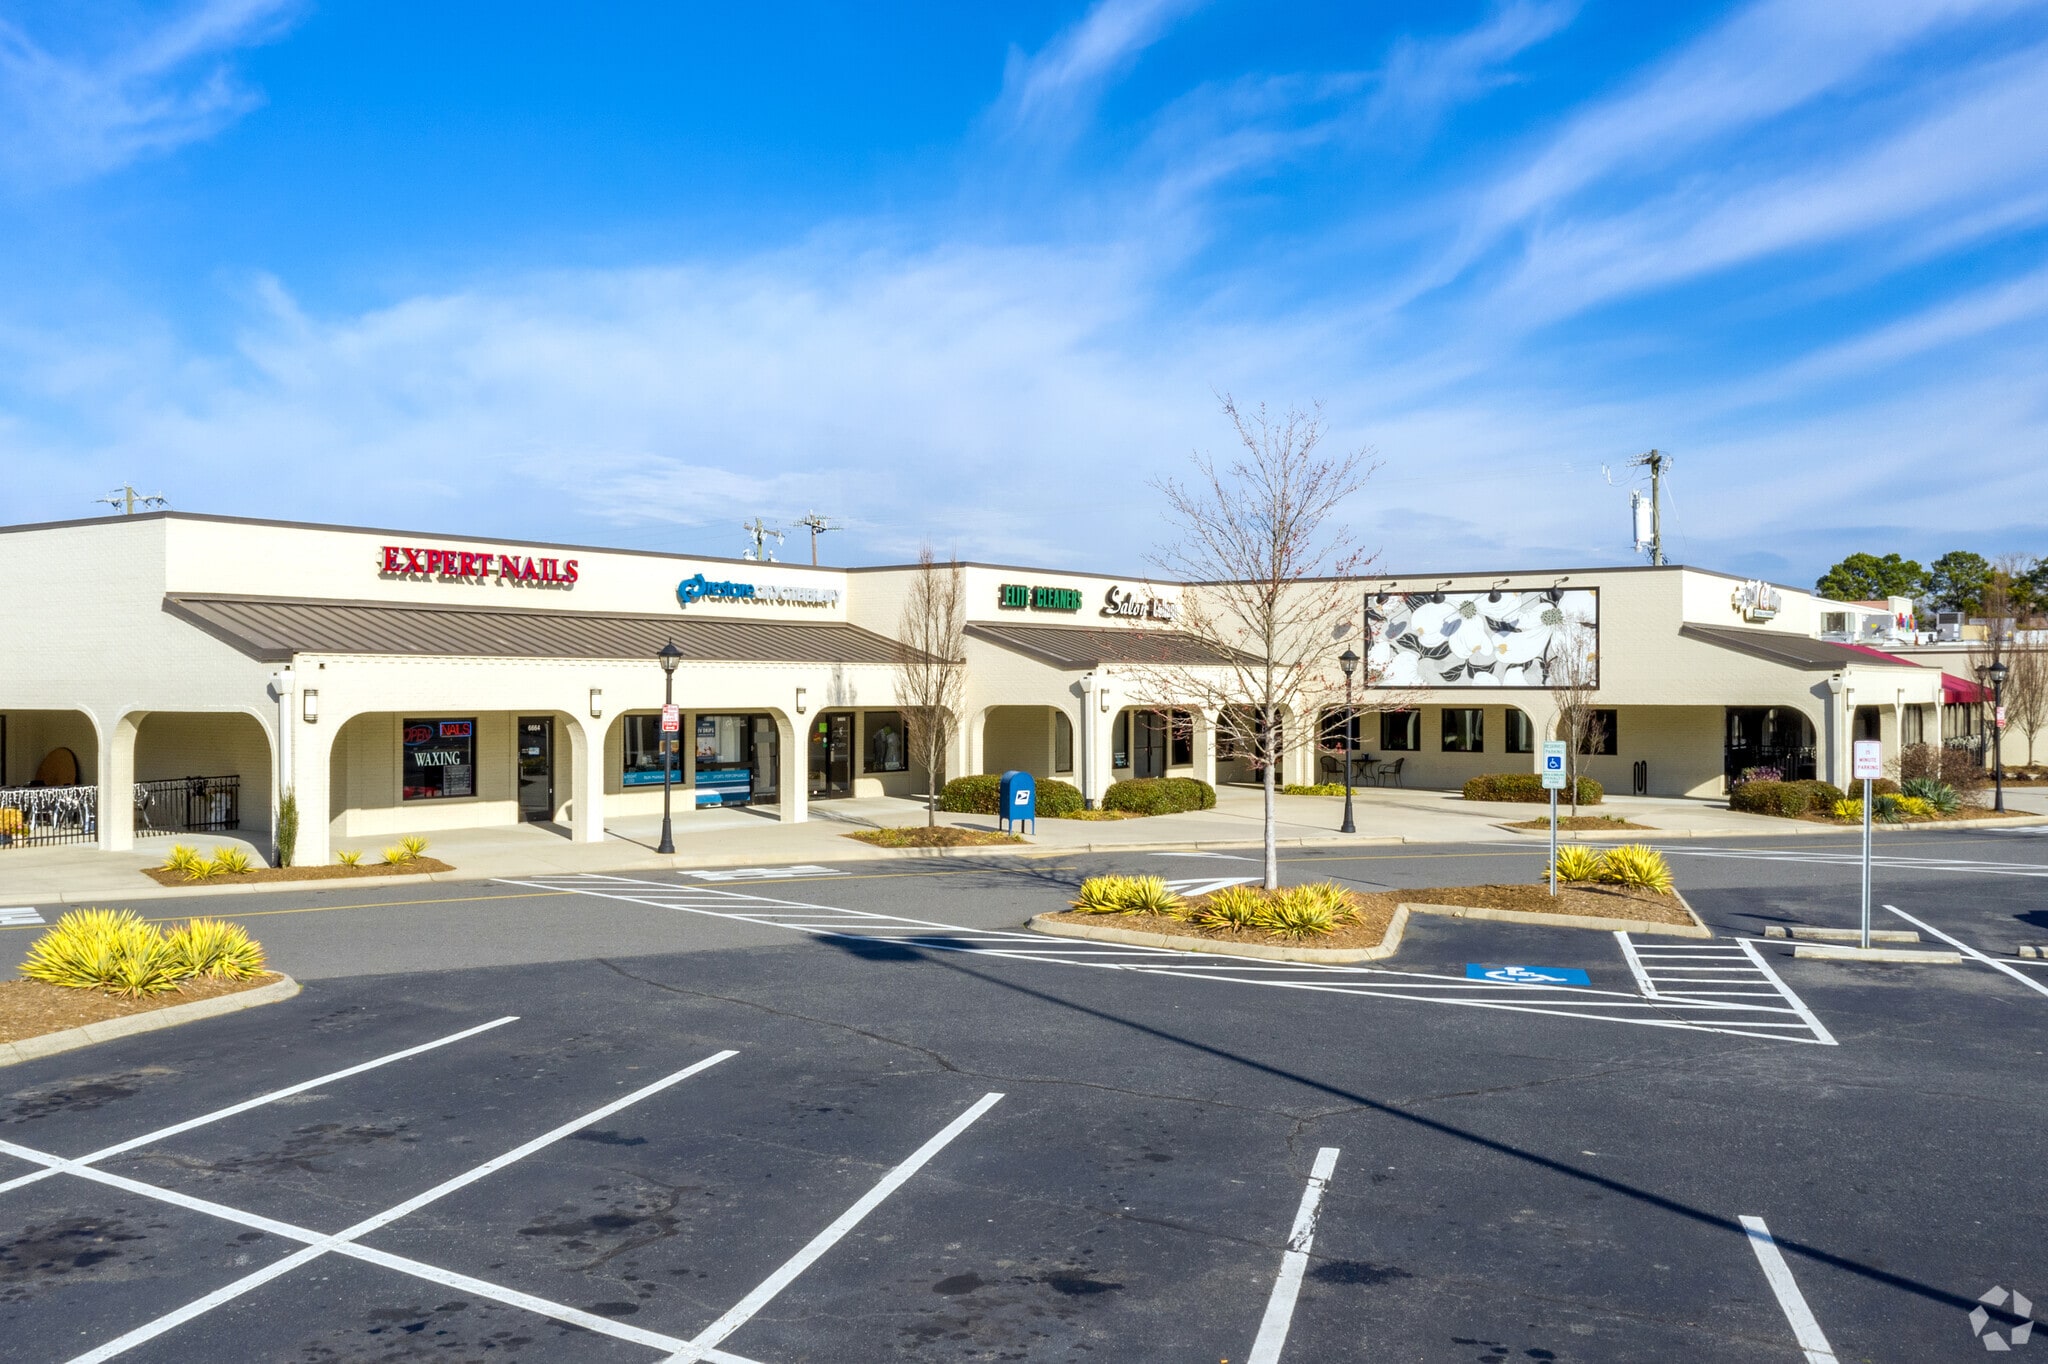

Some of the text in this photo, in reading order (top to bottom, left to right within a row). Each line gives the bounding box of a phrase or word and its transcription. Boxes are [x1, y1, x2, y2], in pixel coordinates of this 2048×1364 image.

[383, 546, 579, 583] EXPERT NAILS
[706, 580, 842, 603] restore CRYOTHERAPY
[1005, 584, 1083, 610] ELITE CLEANERS
[1105, 586, 1147, 616] Salon
[403, 727, 431, 743] OPEN
[414, 750, 461, 767] WAXING
